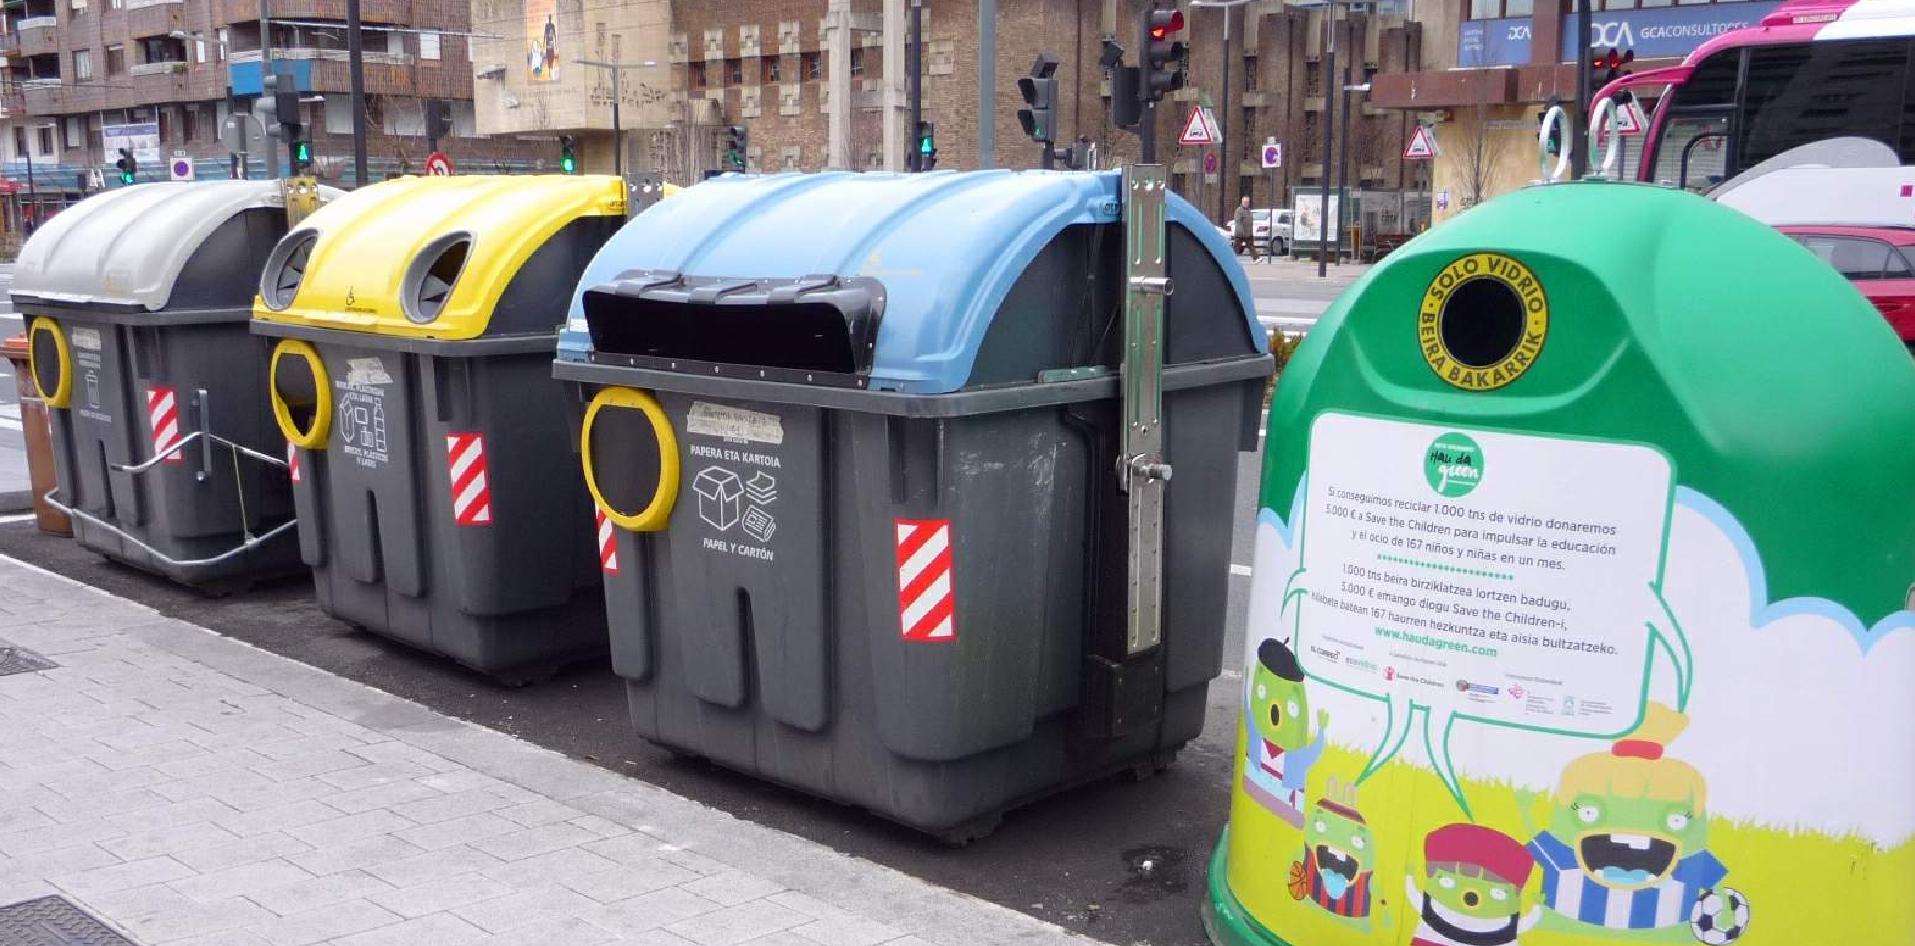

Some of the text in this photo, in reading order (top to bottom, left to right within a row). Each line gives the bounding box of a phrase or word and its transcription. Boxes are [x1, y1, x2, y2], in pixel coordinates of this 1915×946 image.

[1431, 257, 1543, 313] SOLO VIDRIO
[1422, 313, 1542, 387] BEIRA BAKARRIK
[690, 445, 722, 460] PAPERA
[724, 450, 740, 461] ETA
[1438, 465, 1478, 493] green
[1325, 503, 1616, 555] 5.000 € a Save the Children para impulsar la educación
[1337, 488, 1393, 508] conseguimos
[1395, 499, 1431, 513] reciclar
[1468, 508, 1485, 520] tns
[1489, 510, 1504, 523] de
[1507, 513, 1542, 527] vidrio
[1545, 518, 1617, 536] donaremos
[704, 537, 774, 561] PAPEL Y CARTÓN
[1352, 529, 1357, 540] y
[1369, 533, 1389, 544] ocio
[1391, 535, 1403, 547] de
[1406, 537, 1423, 550] 167
[1426, 541, 1454, 555] niños
[1456, 548, 1463, 559] y
[1466, 548, 1496, 561] niñas
[1500, 553, 1514, 565] en
[1519, 555, 1533, 566] un
[1537, 559, 1566, 571] mes.
[1342, 581, 1567, 631] 5.000 € emango diogu Save the Children-i,
[1367, 569, 1382, 581] tns
[1384, 572, 1408, 587] beira
[1411, 577, 1473, 597] birziklatzea
[1476, 587, 1516, 603] lortzen
[1340, 599, 1368, 615] batean
[1371, 607, 1385, 619] 167
[1388, 610, 1426, 628] haurren
[1431, 618, 1485, 638] hezkuntza
[1489, 630, 1507, 642] eta
[1511, 633, 1539, 647] aisia
[1543, 636, 1618, 656] bultzatzeko.
[1375, 626, 1497, 658] www.haudagreen.com
